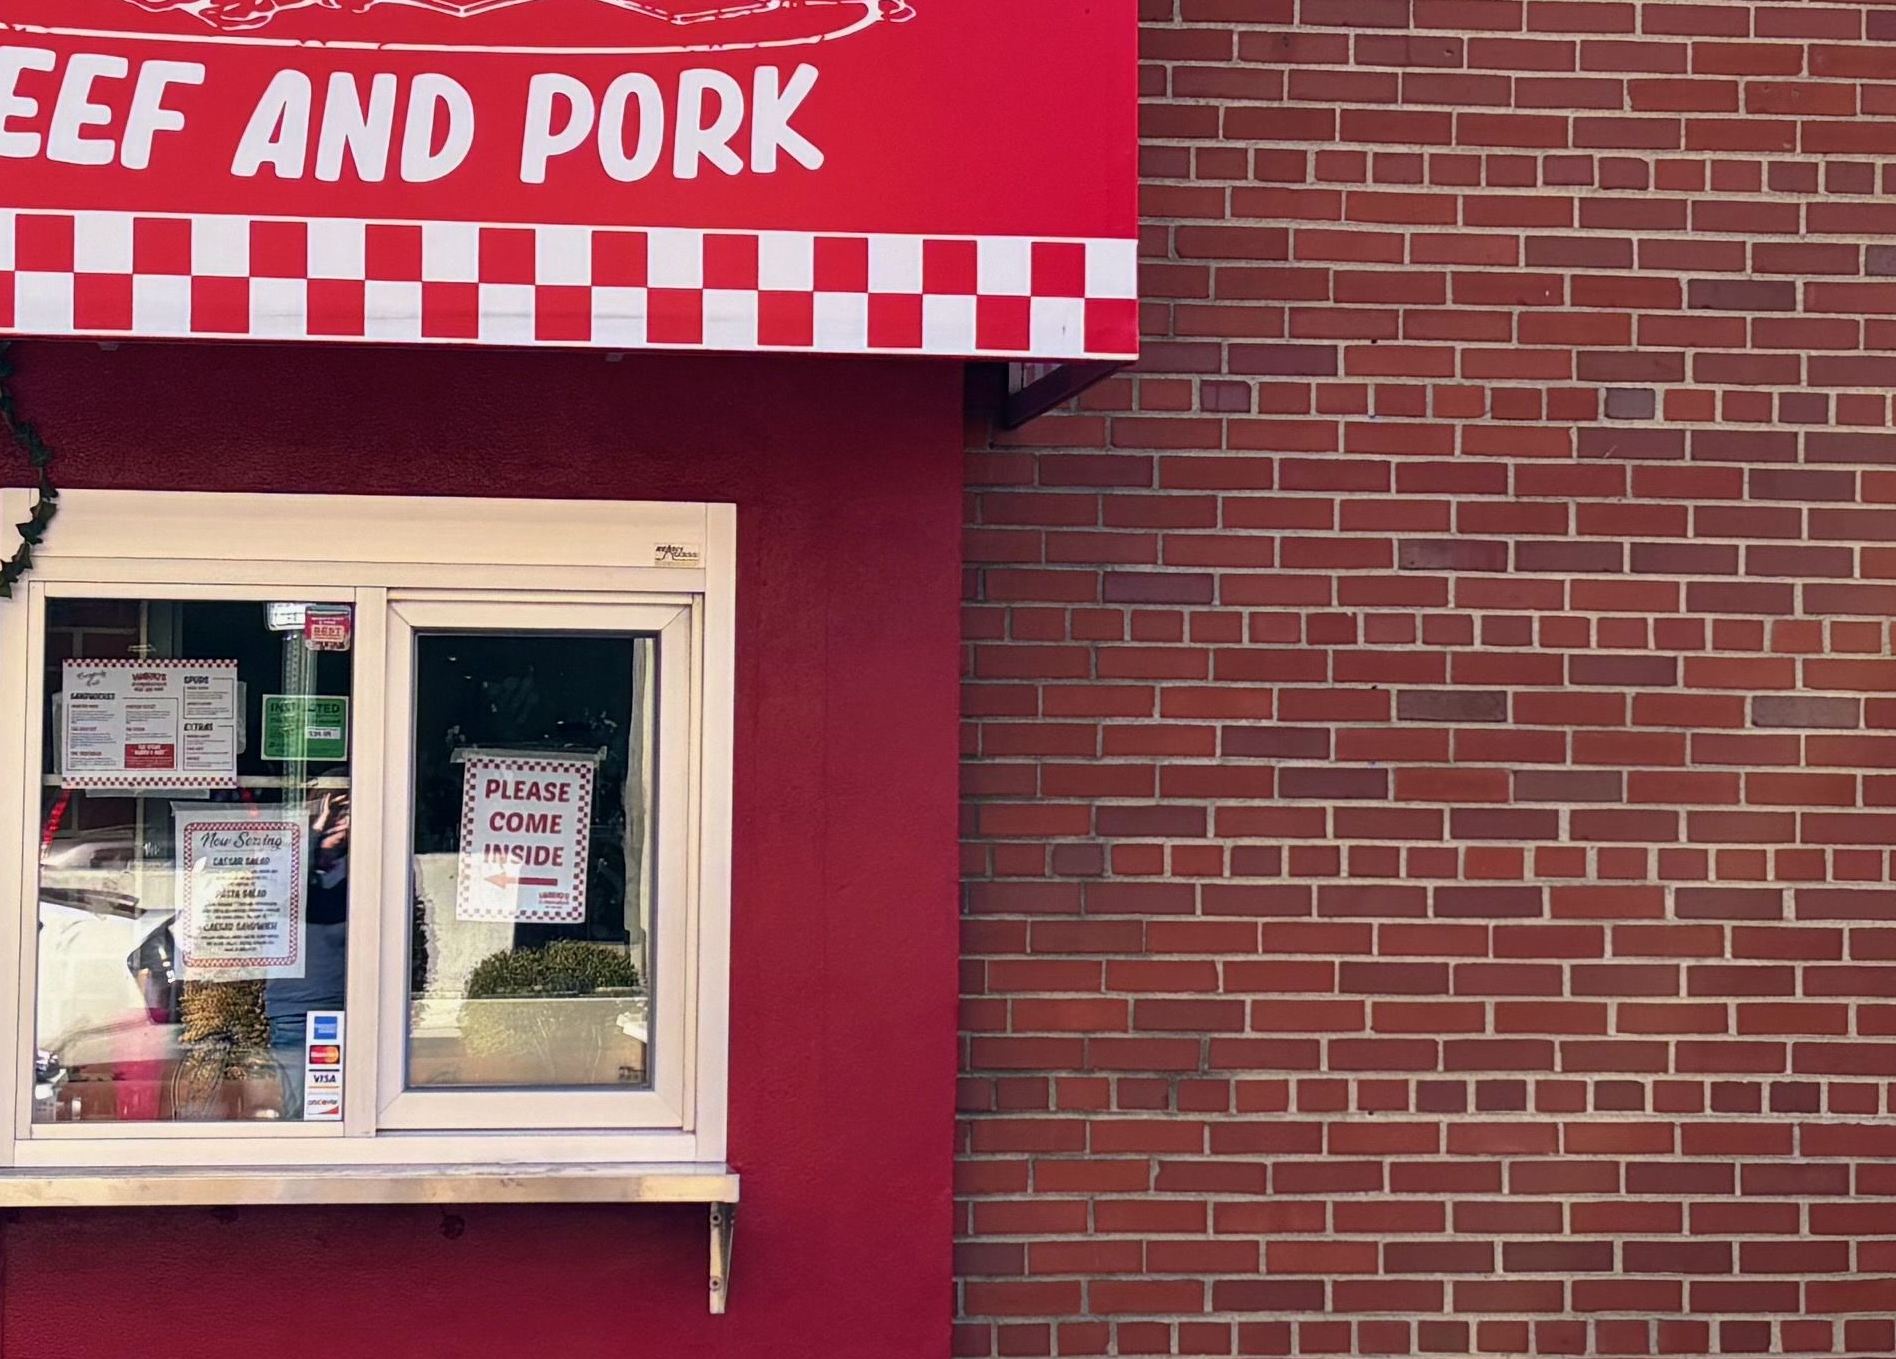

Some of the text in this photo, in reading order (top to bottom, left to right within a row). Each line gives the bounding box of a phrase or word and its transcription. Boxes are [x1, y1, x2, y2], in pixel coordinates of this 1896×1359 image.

[230, 70, 476, 184] AND
[519, 64, 825, 185] PORK
[270, 703, 340, 714] INSTED
[485, 779, 571, 802] PLEASE
[489, 811, 563, 834] COME
[200, 832, 230, 848] Now
[483, 843, 564, 867] INSIDE
[313, 1074, 337, 1083] VISA
